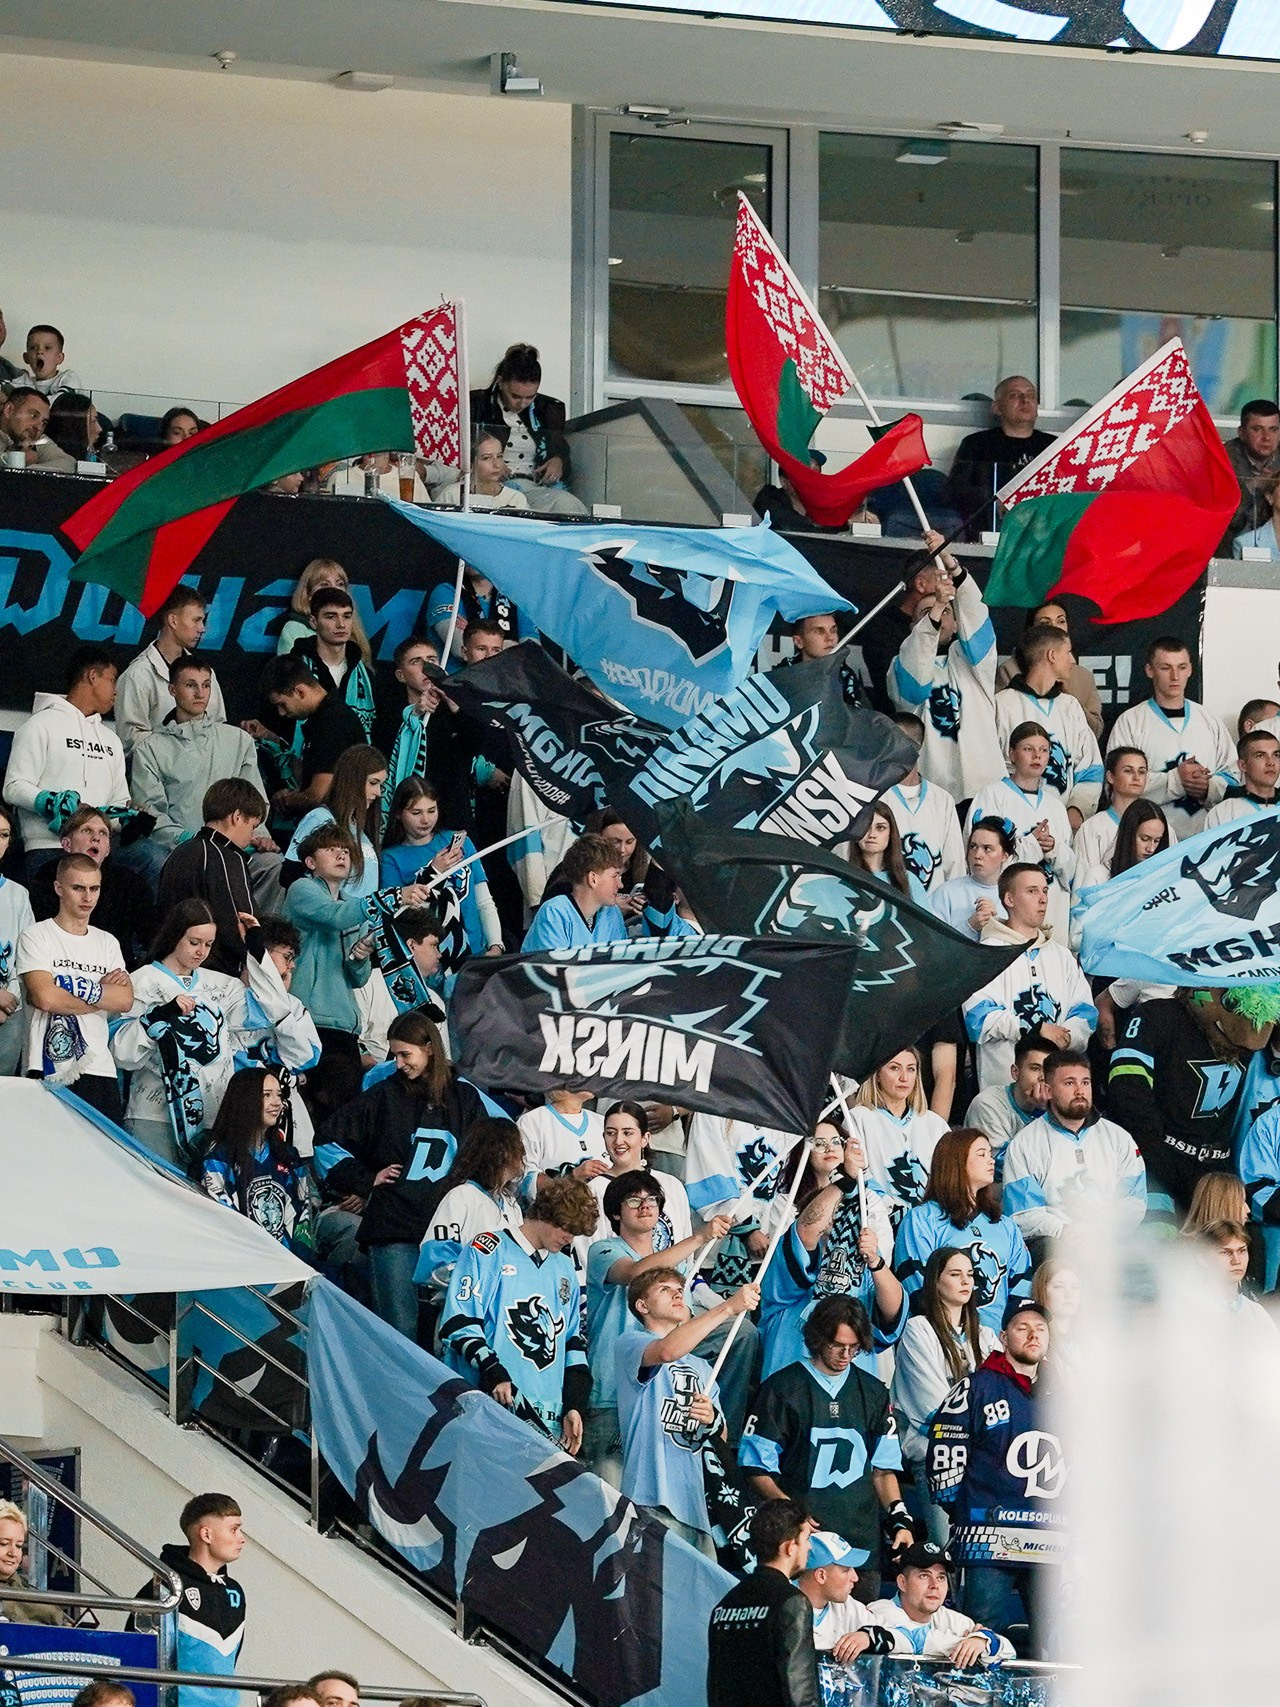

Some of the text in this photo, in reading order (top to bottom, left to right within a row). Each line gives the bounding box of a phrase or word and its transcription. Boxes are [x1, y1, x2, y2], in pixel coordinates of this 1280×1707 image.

[1125, 1016, 1142, 1039] 8
[983, 1398, 1011, 1427] 88
[744, 1414, 758, 1437] 6
[886, 1416, 899, 1440] 2
[933, 1444, 968, 1472] 88
